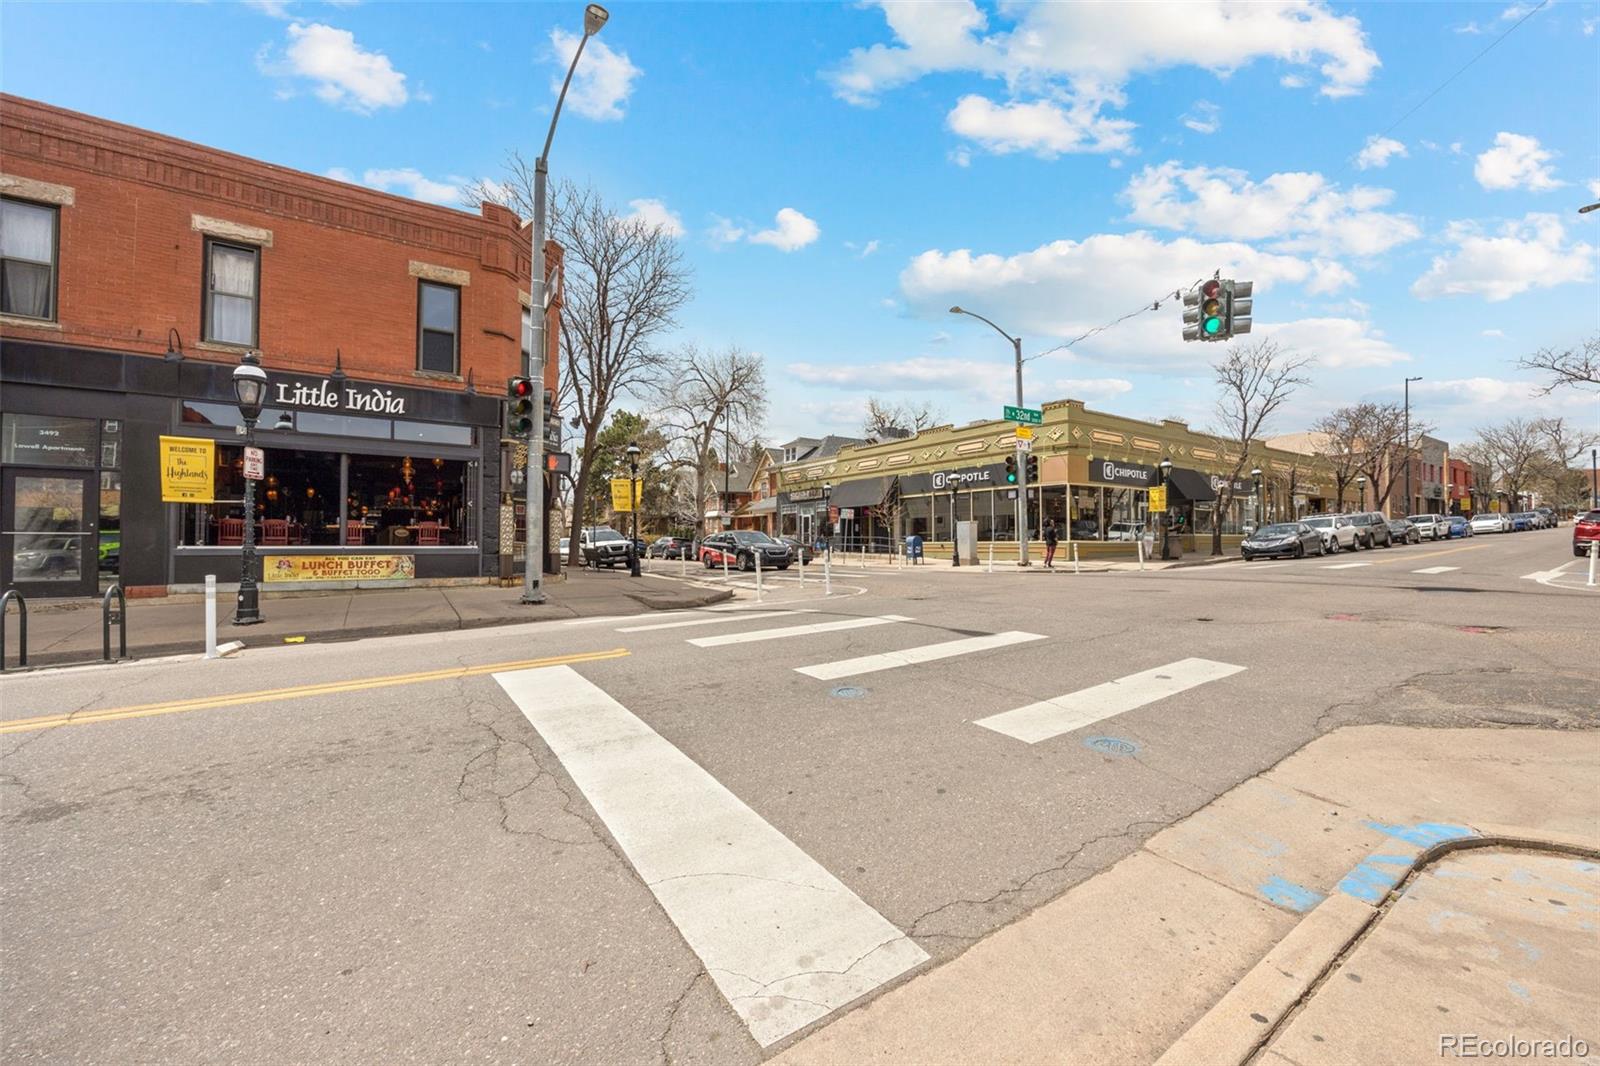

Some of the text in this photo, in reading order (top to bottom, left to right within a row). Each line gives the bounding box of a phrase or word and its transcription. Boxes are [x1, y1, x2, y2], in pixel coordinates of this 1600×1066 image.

[276, 380, 406, 414] Little India
[1015, 410, 1031, 421] 32nd
[42, 444, 86, 452] Apartments
[167, 466, 208, 480] Highlands
[945, 470, 991, 484] CPOTLE
[1114, 467, 1148, 480] CHIPOTLE
[301, 560, 392, 570] LUNCH BUFFET
